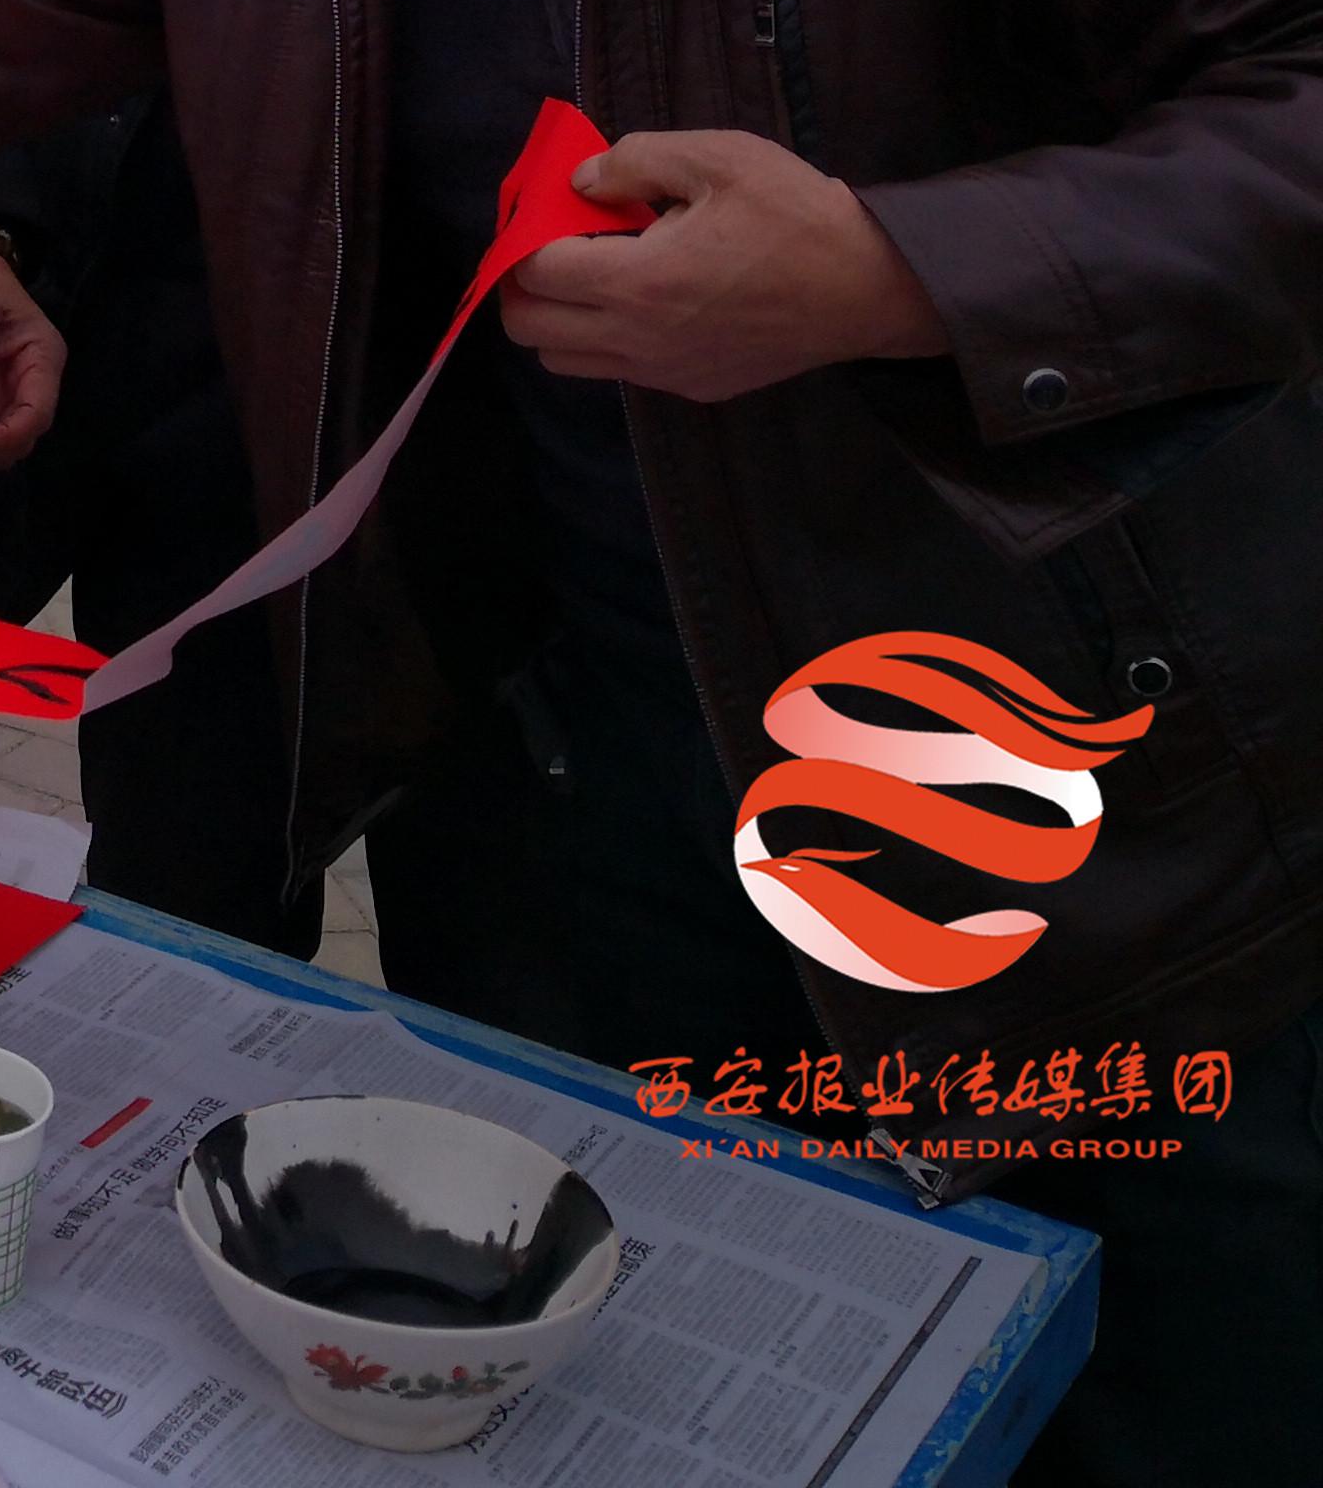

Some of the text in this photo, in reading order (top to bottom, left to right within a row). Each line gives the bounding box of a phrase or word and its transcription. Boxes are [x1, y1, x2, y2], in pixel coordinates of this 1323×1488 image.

[51, 1167, 145, 1245] 做事知不足
